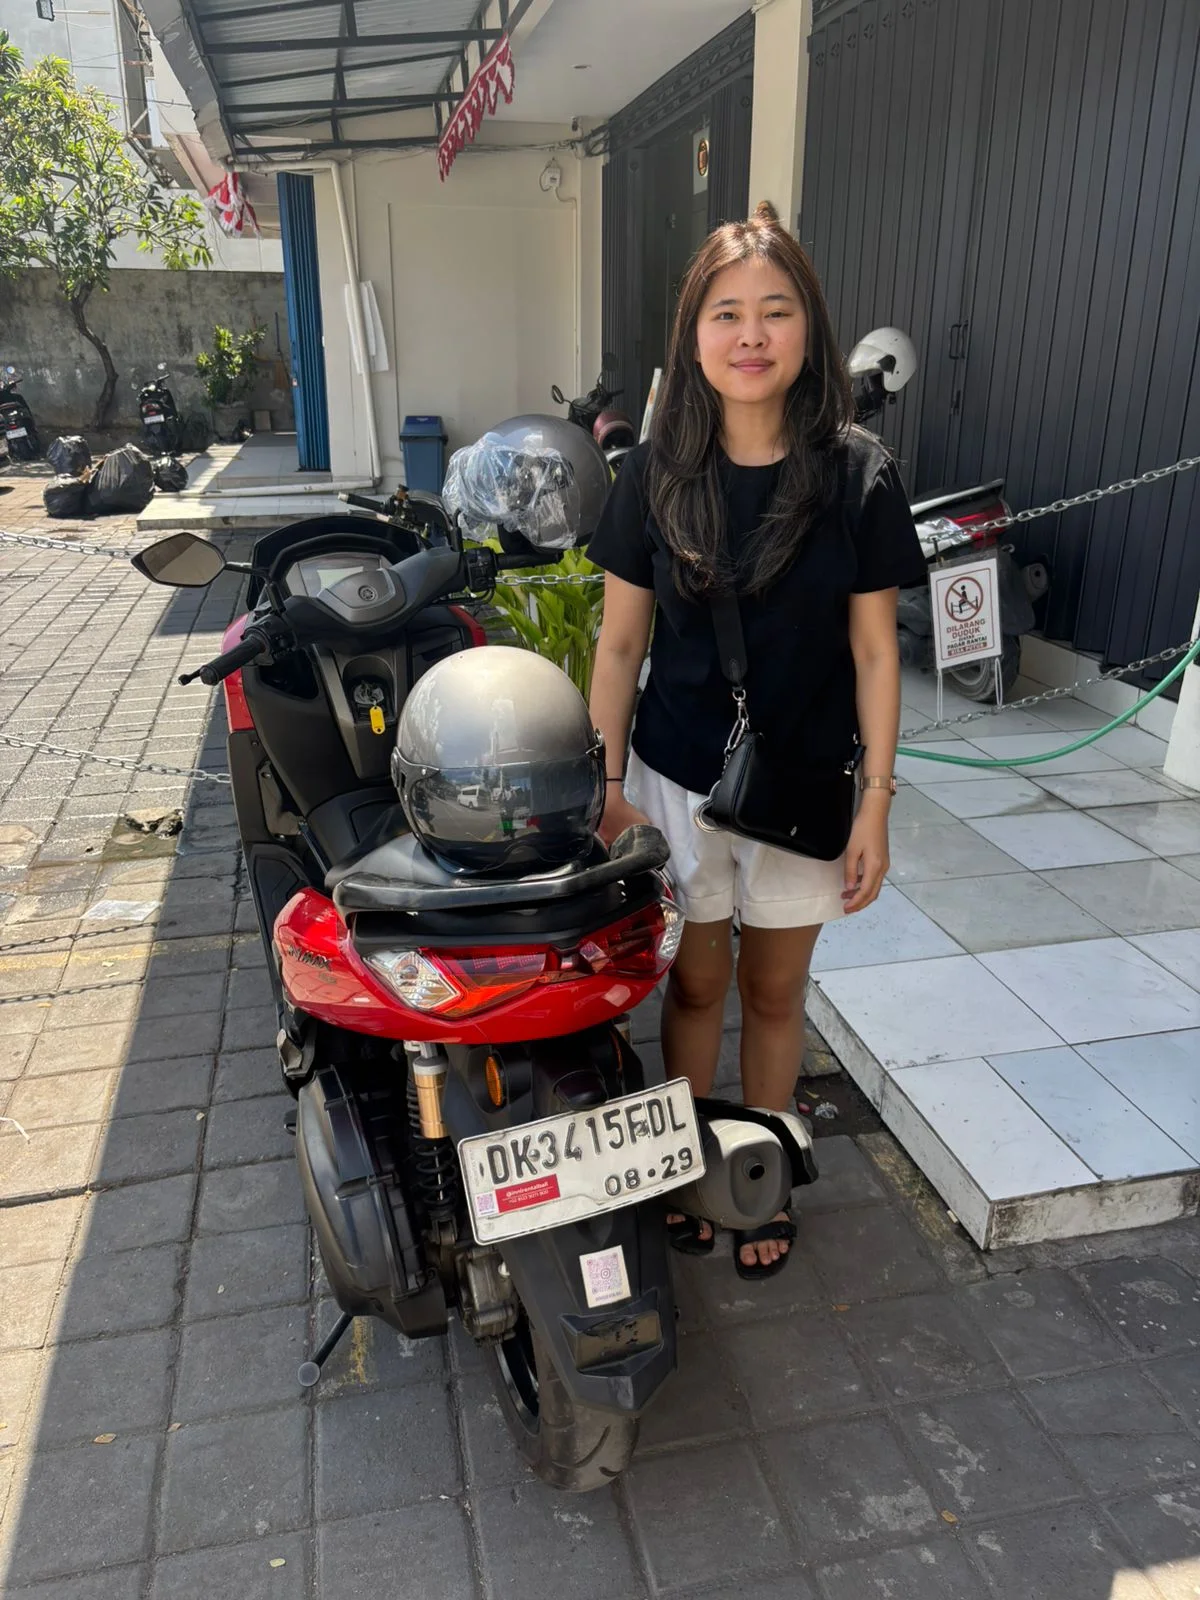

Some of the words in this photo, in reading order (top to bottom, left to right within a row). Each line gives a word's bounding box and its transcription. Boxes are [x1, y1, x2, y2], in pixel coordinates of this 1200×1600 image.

[946, 618, 986, 633] DILARANG
[952, 626, 980, 639] DUDUK
[486, 1133, 538, 1185] DK
[537, 1108, 625, 1170] 3415
[625, 1095, 687, 1145] FDL
